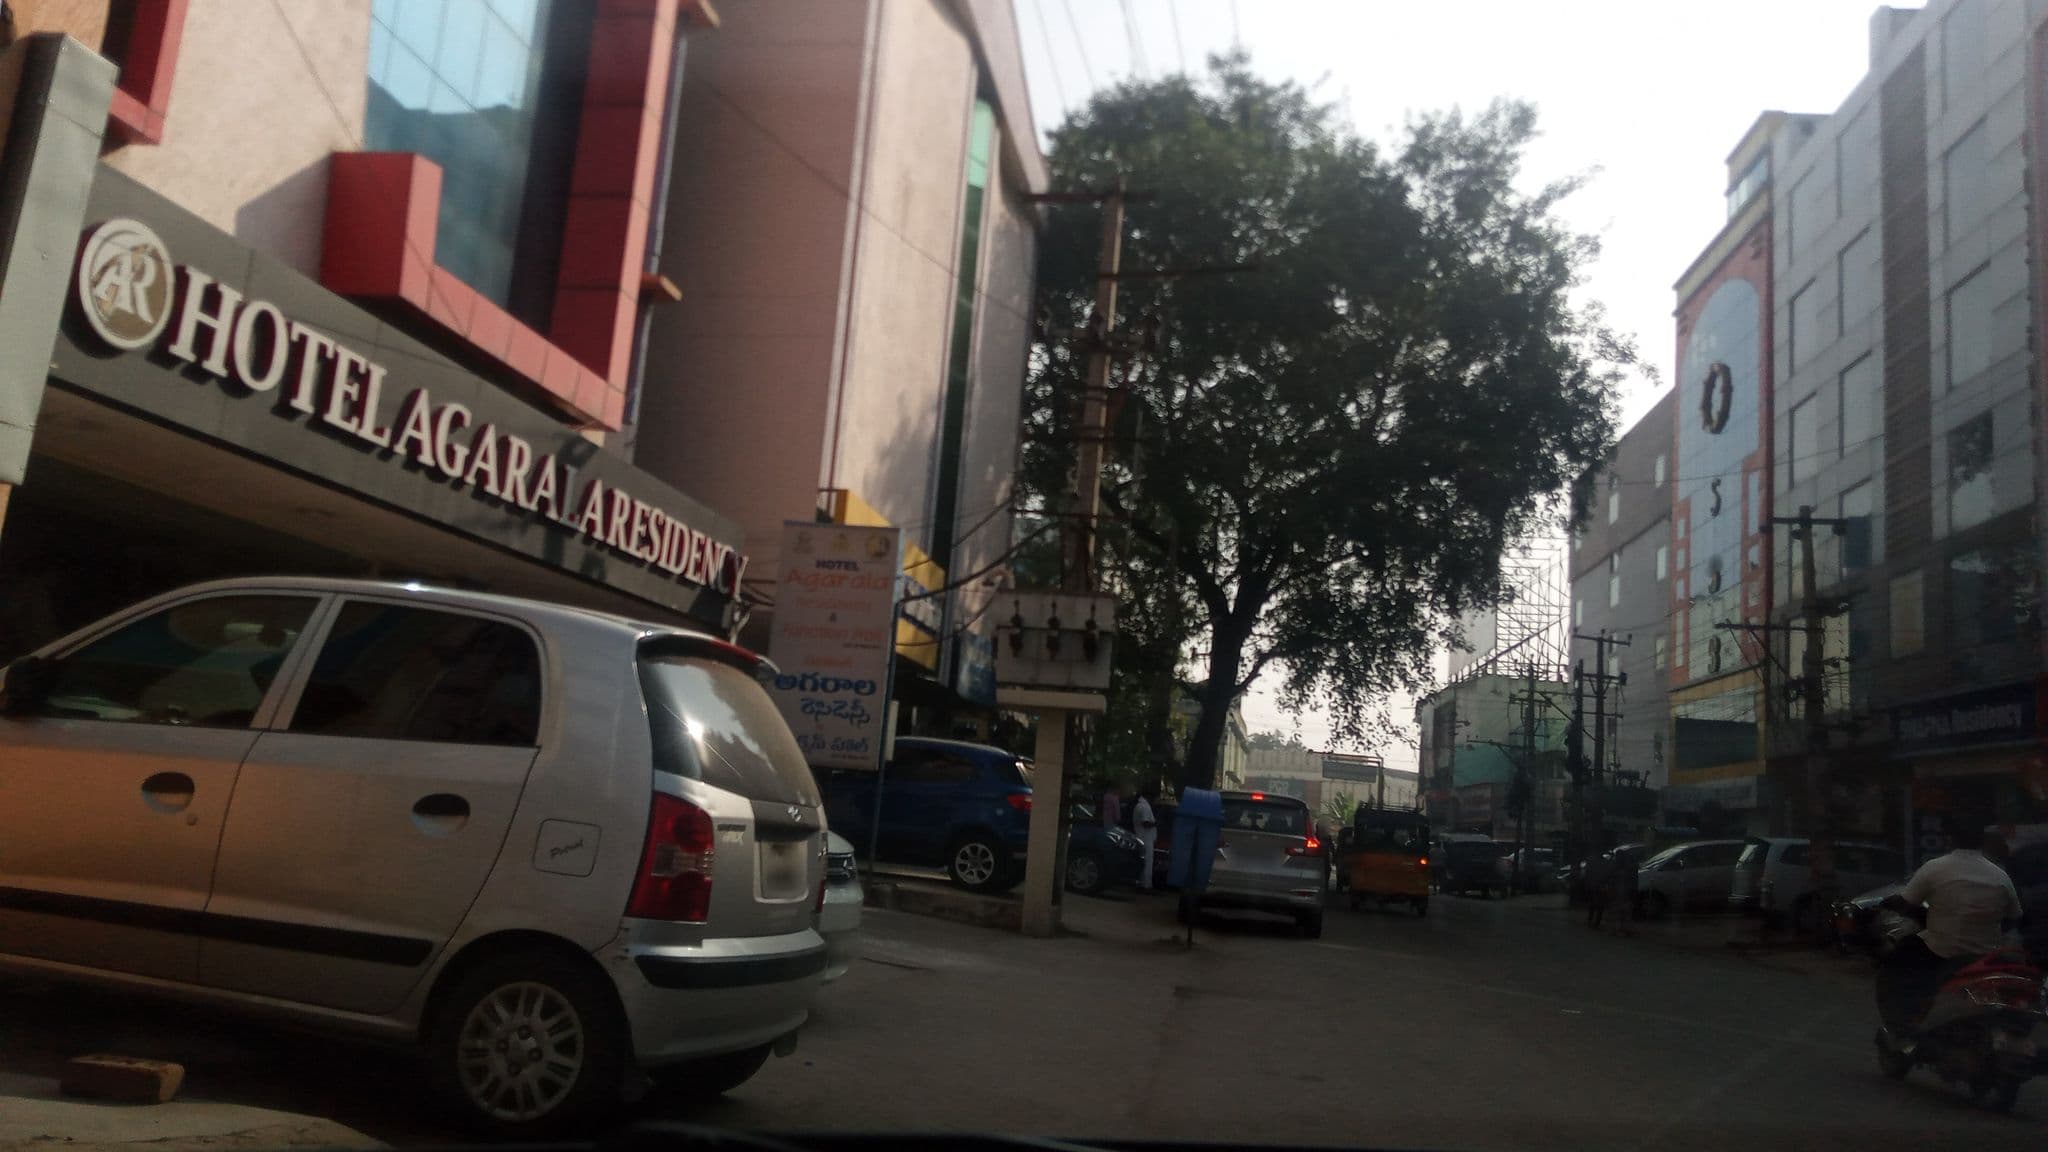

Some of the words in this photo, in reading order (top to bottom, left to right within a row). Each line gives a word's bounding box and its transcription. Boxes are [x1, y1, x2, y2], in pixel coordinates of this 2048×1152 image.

[168, 265, 389, 448] HOTEL
[393, 387, 608, 543] AGARALA
[605, 486, 749, 603] RESIDENCY
[815, 559, 859, 572] HOTEL
